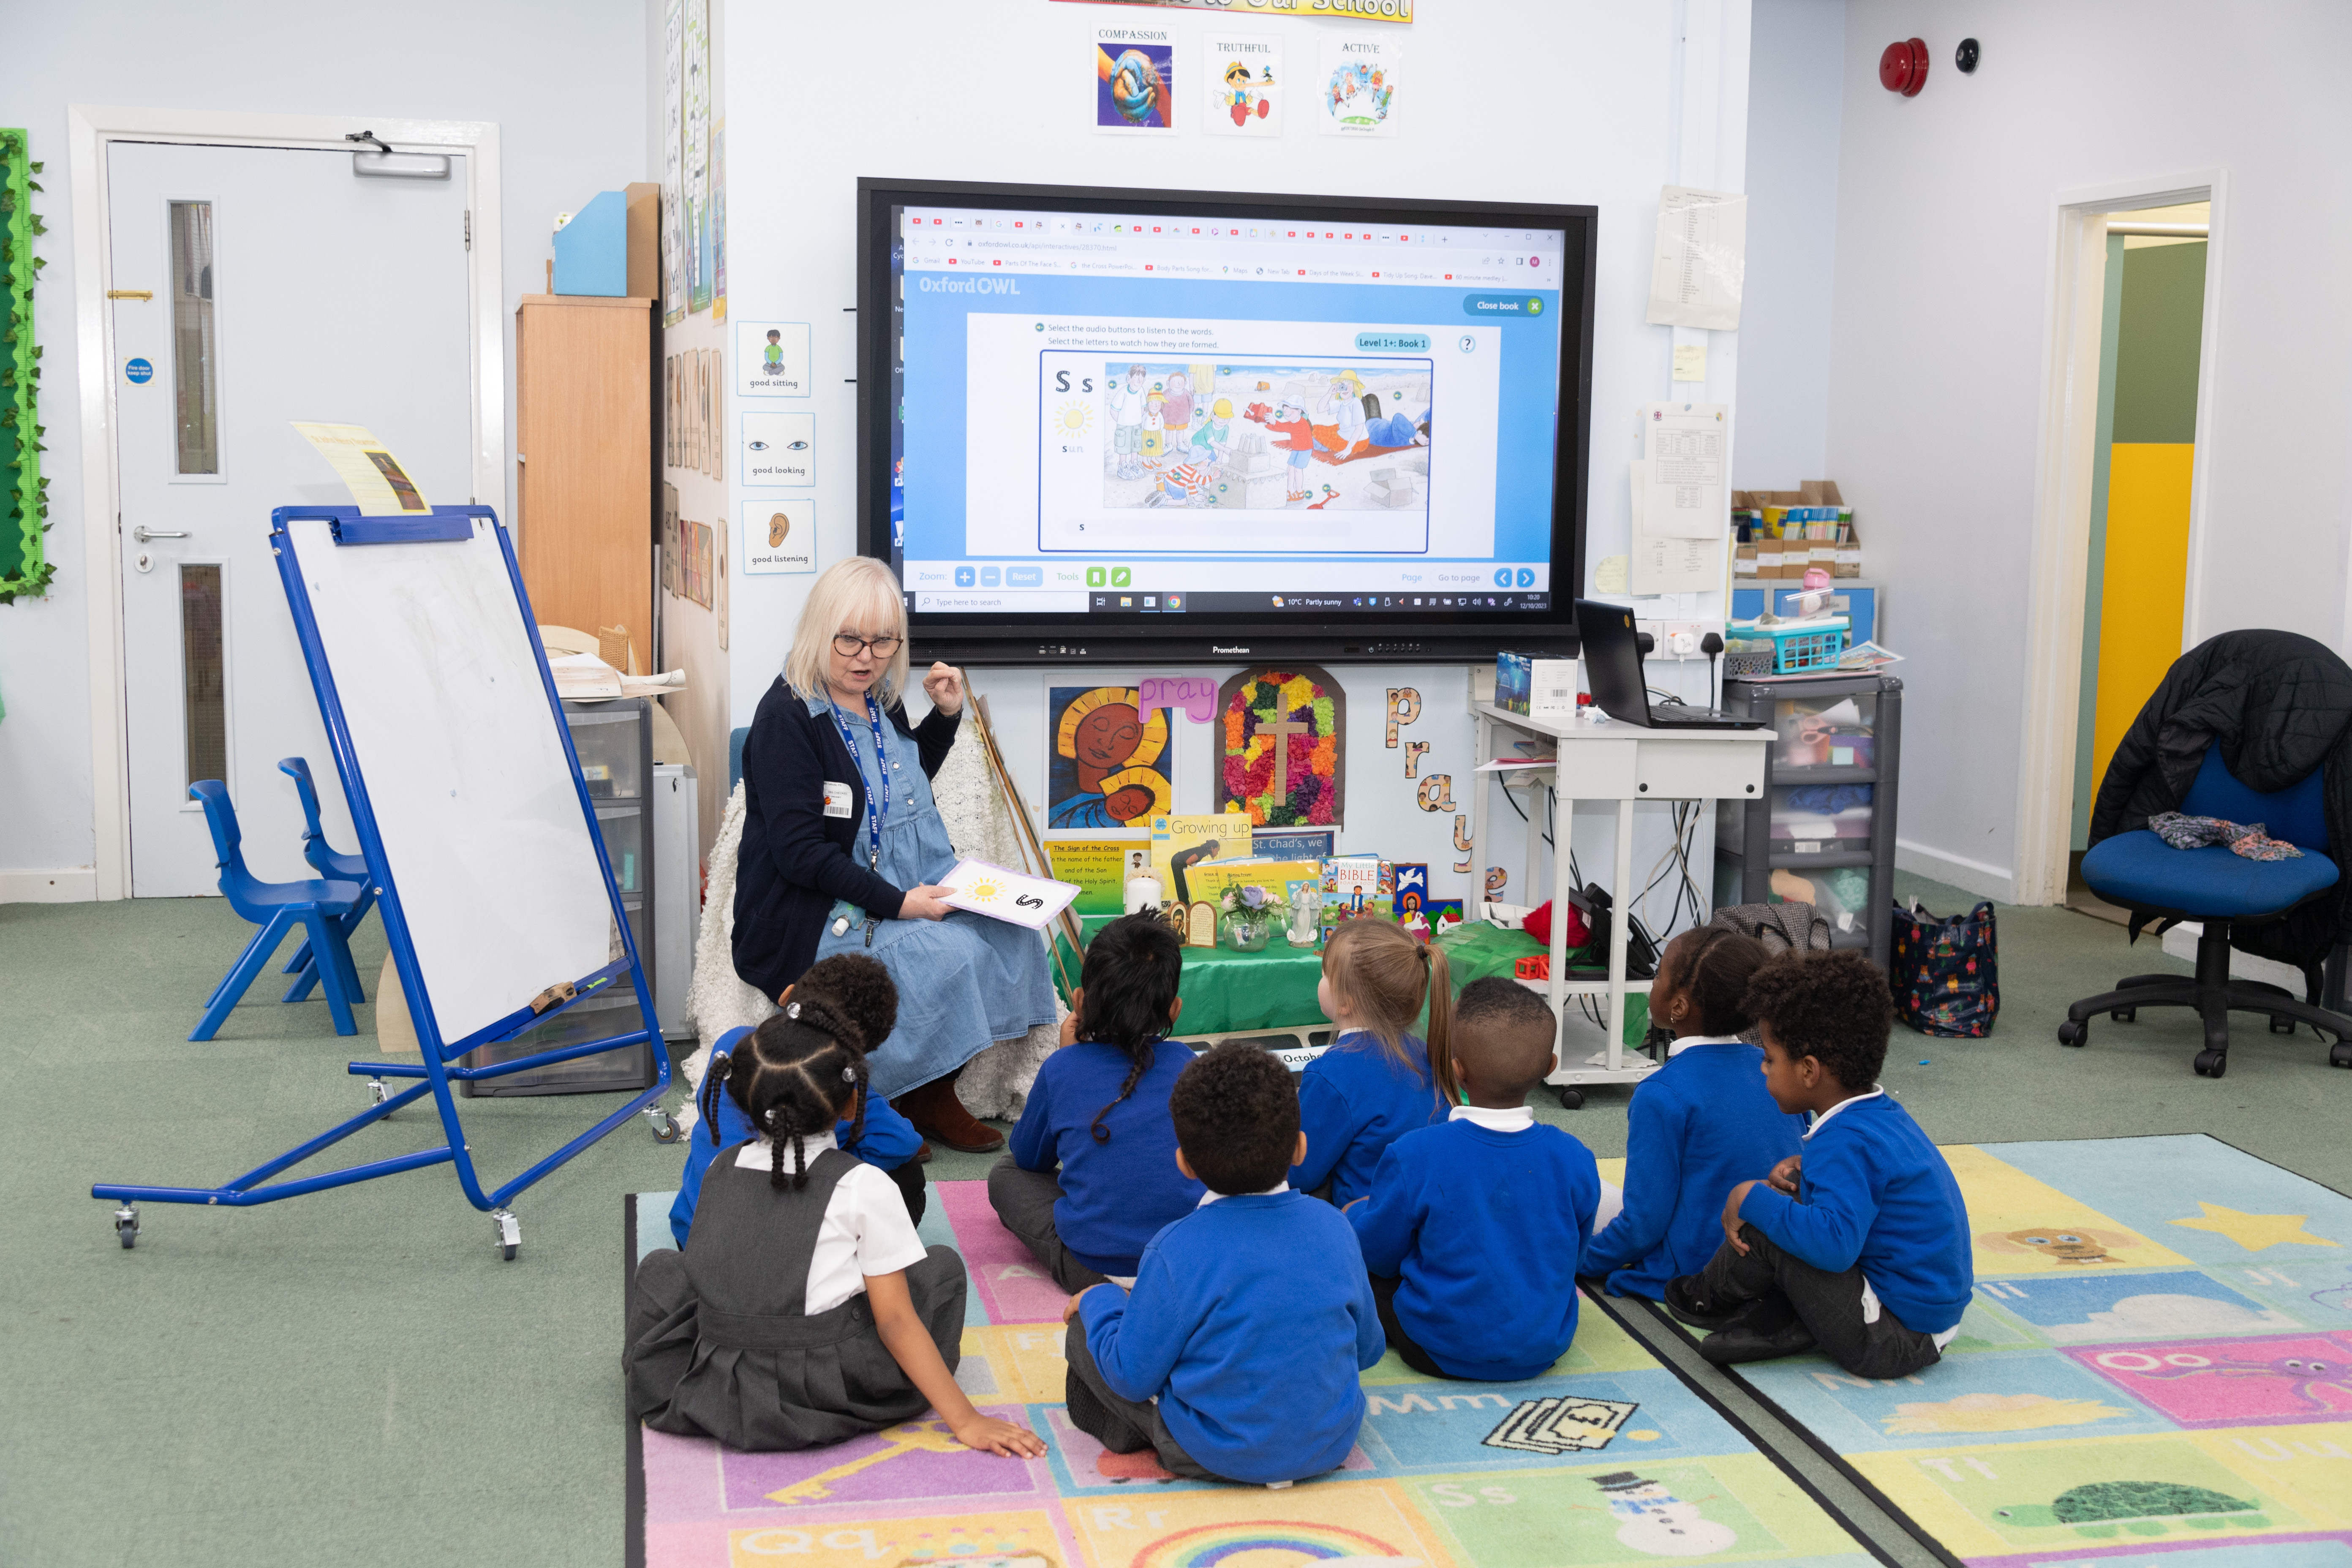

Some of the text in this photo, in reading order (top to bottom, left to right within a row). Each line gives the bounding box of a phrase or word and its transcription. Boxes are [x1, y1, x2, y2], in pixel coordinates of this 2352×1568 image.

[1099, 29, 1167, 40] COMPASSION
[1217, 43, 1270, 53] TRUTHFUL
[1342, 43, 1380, 54] ACTIVE
[978, 241, 1116, 251] oxfordowl.co.uk/api/interactives/28370.html
[1477, 301, 1519, 310] Close book
[1161, 340, 1176, 349] they
[1192, 340, 1219, 348] formed.
[1359, 338, 1381, 346] Level
[750, 379, 798, 389] good sitting
[1056, 370, 1070, 392] S
[753, 466, 805, 476] good looking
[752, 554, 808, 565] good listening
[920, 572, 947, 581] Zoom:
[1013, 572, 1037, 581] Reset
[1057, 573, 1079, 581] Tools
[1402, 573, 1422, 583] Page
[1460, 576, 1480, 584] page
[936, 598, 952, 607] Type
[1306, 599, 1322, 607] Partly
[1140, 680, 1215, 721] pray
[869, 707, 877, 723] STAFF
[838, 714, 849, 731] STAFF
[848, 740, 859, 758] STAFF
[1172, 820, 1249, 837] Growing up
[1253, 840, 1266, 849] St.
[1308, 839, 1323, 847] we
[1340, 869, 1375, 881] BIBLE
[1283, 1053, 1323, 1062] Octobe
[997, 1266, 1043, 1281] A
[1369, 1393, 1511, 1416] Mm
[1919, 1457, 1998, 1483] Tt
[1430, 1482, 1518, 1507] Ss
[1090, 1507, 1170, 1531] Rr
[741, 1529, 892, 1560] Qq
